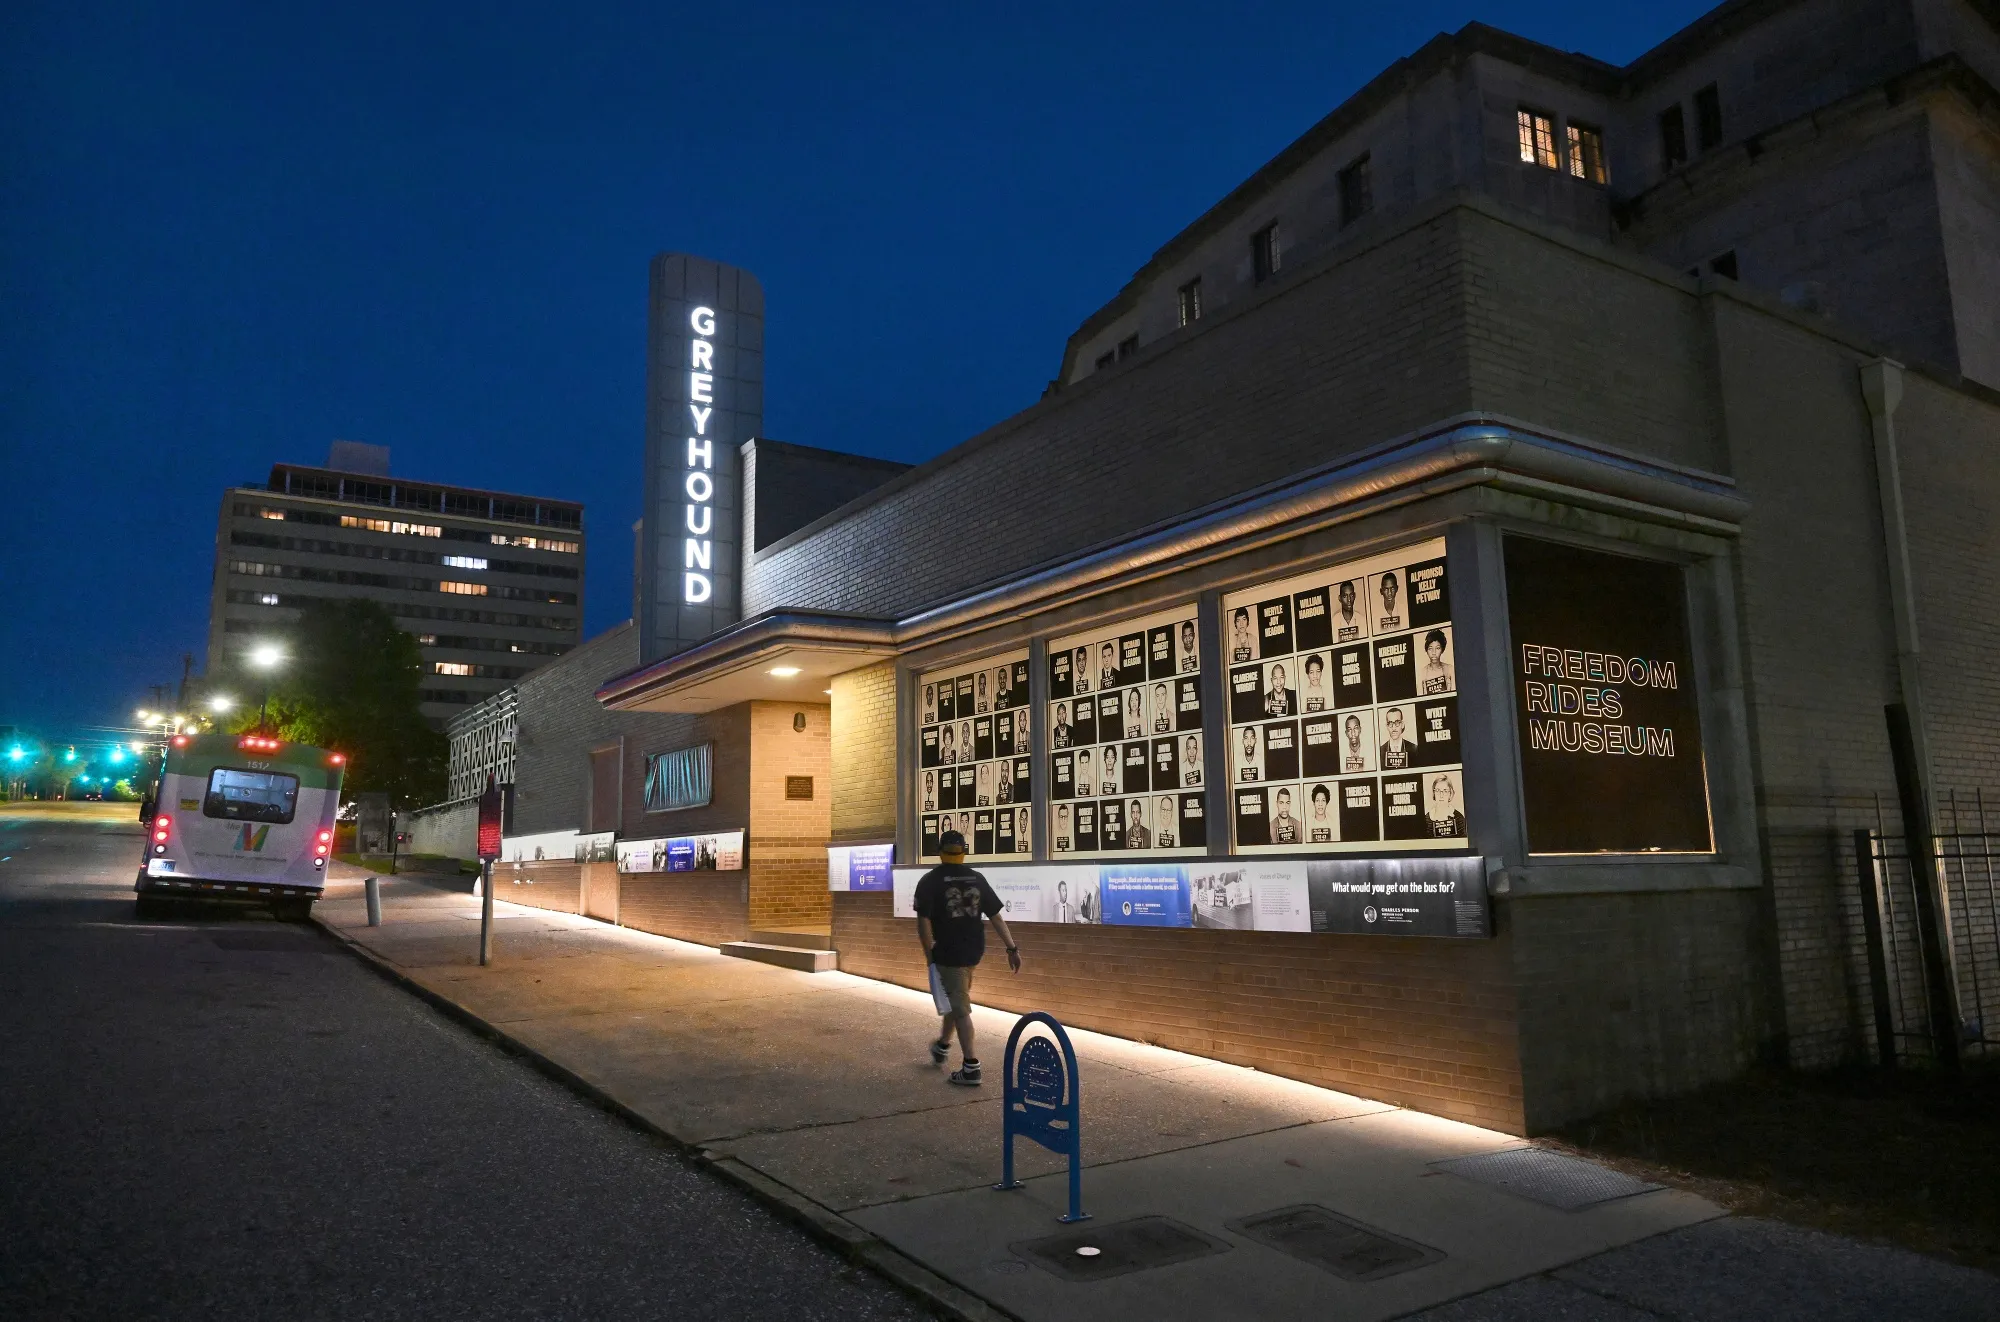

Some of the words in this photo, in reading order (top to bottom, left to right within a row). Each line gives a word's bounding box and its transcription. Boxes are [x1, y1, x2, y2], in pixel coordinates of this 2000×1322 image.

[685, 306, 715, 603] GREYHOUND
[1411, 566, 1444, 583] ALPHONSO
[1419, 579, 1436, 593] KELLY
[1300, 595, 1322, 609] WILLIAM
[1416, 589, 1441, 604] PETWAY
[1381, 654, 1405, 669] PETWAY
[1522, 643, 1677, 690] FREEDOM
[1525, 680, 1623, 719] RIDES
[1425, 706, 1446, 719] WYATT
[1431, 719, 1443, 730] TEE
[1425, 729, 1451, 742] WALKER
[1529, 718, 1675, 757] MUSEUM
[1345, 786, 1371, 797] THERESA
[1385, 782, 1417, 794] MARGARET
[1347, 797, 1371, 808] WALKER
[1393, 794, 1410, 805] BURR
[1389, 805, 1416, 816] LEONARD
[1332, 882, 1349, 893] What
[1351, 882, 1370, 893] would
[1372, 884, 1384, 895] you
[1386, 883, 1397, 895] get
[1399, 884, 1408, 893] on
[1410, 882, 1422, 893] the
[1423, 882, 1437, 893] bus
[1439, 882, 1455, 893] for?
